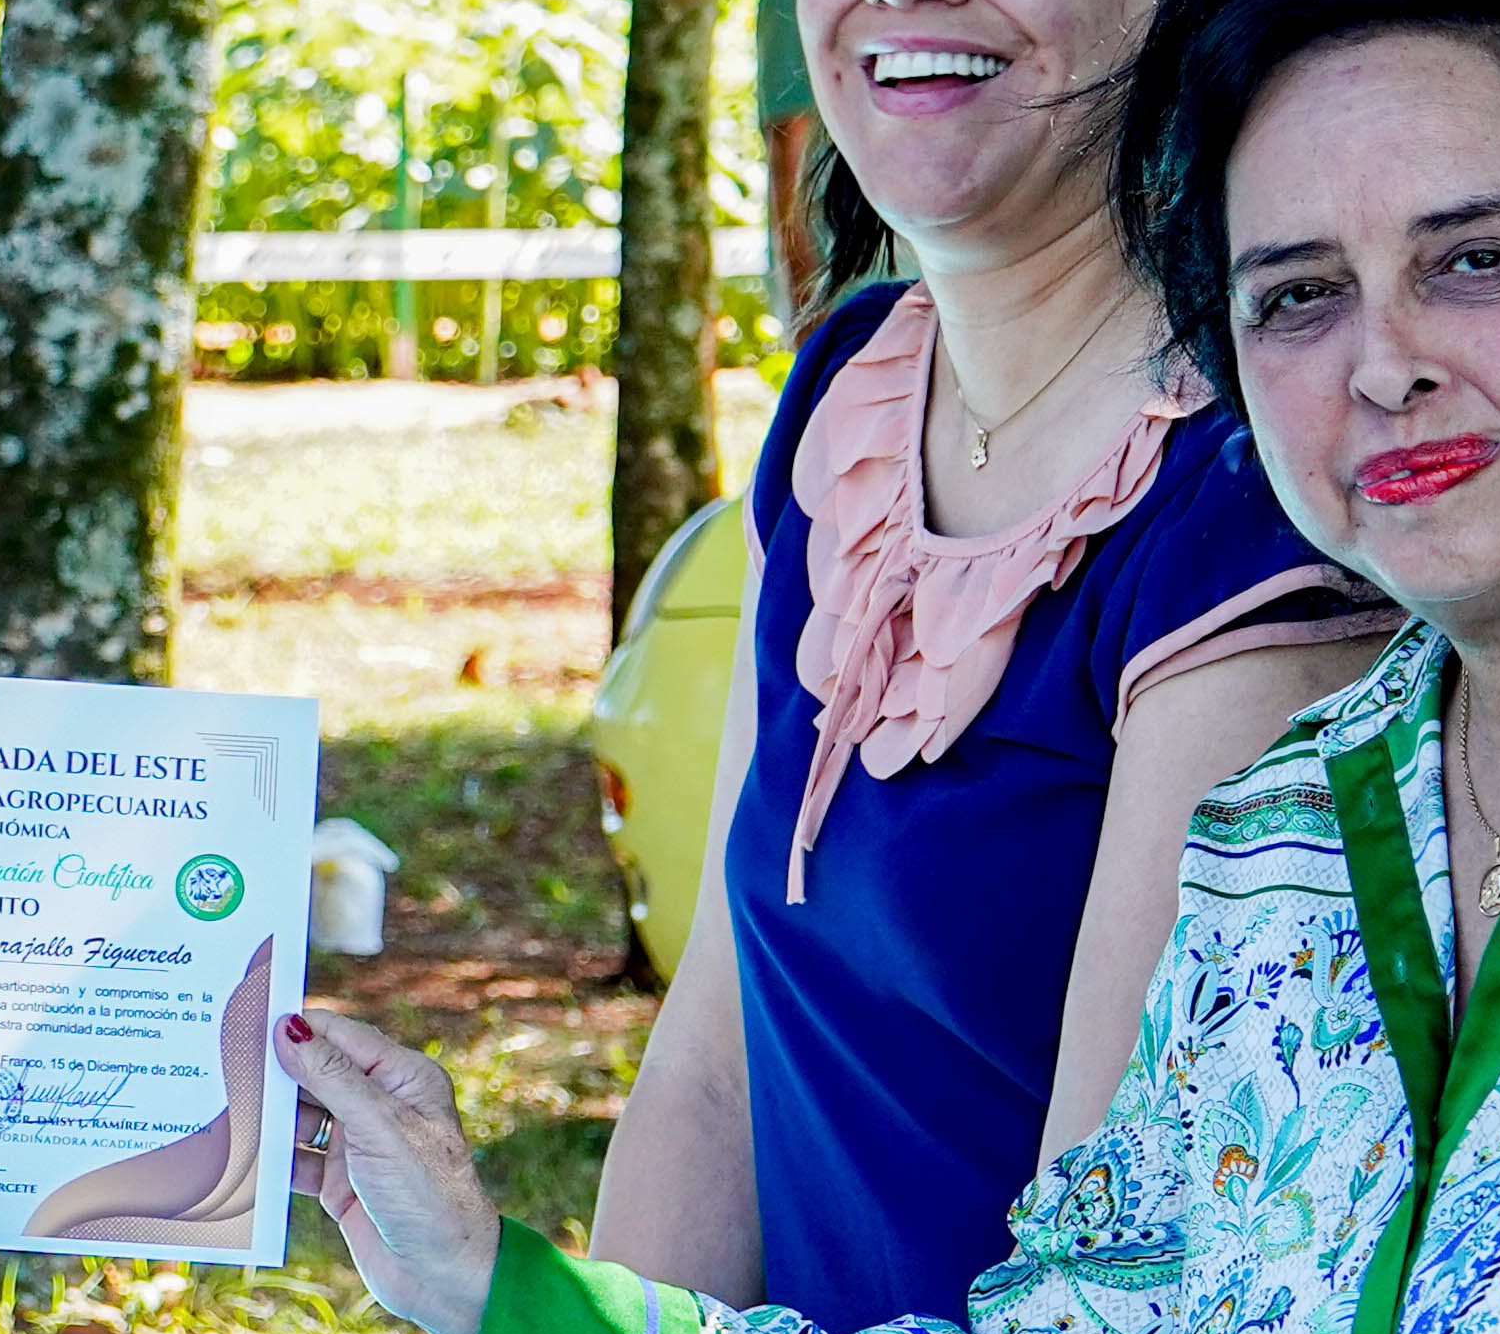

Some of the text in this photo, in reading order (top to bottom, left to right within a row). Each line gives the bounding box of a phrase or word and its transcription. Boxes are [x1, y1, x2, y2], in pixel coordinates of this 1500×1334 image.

[65, 750, 126, 777] DEL
[134, 754, 208, 782] ESTE
[83, 937, 193, 968] Figueredo
[94, 987, 169, 1001] compromiso
[177, 992, 193, 1002] en
[202, 990, 213, 1003] la
[11, 1000, 84, 1015] contribución
[99, 1004, 110, 1017] la
[114, 1007, 178, 1021] promoción
[182, 1009, 197, 1022] de
[201, 1010, 212, 1023] la
[26, 1021, 92, 1035] comunidad
[95, 1024, 164, 1039] académica.
[0, 1053, 47, 1071] Franco,
[51, 1056, 66, 1069] 15
[69, 1057, 84, 1070] de
[87, 1058, 148, 1074] Diciembre
[151, 1062, 166, 1075] de
[169, 1063, 209, 1077] 2024.-
[91, 1113, 149, 1131] RAMÍREZ
[151, 1117, 212, 1135] MONZÓN
